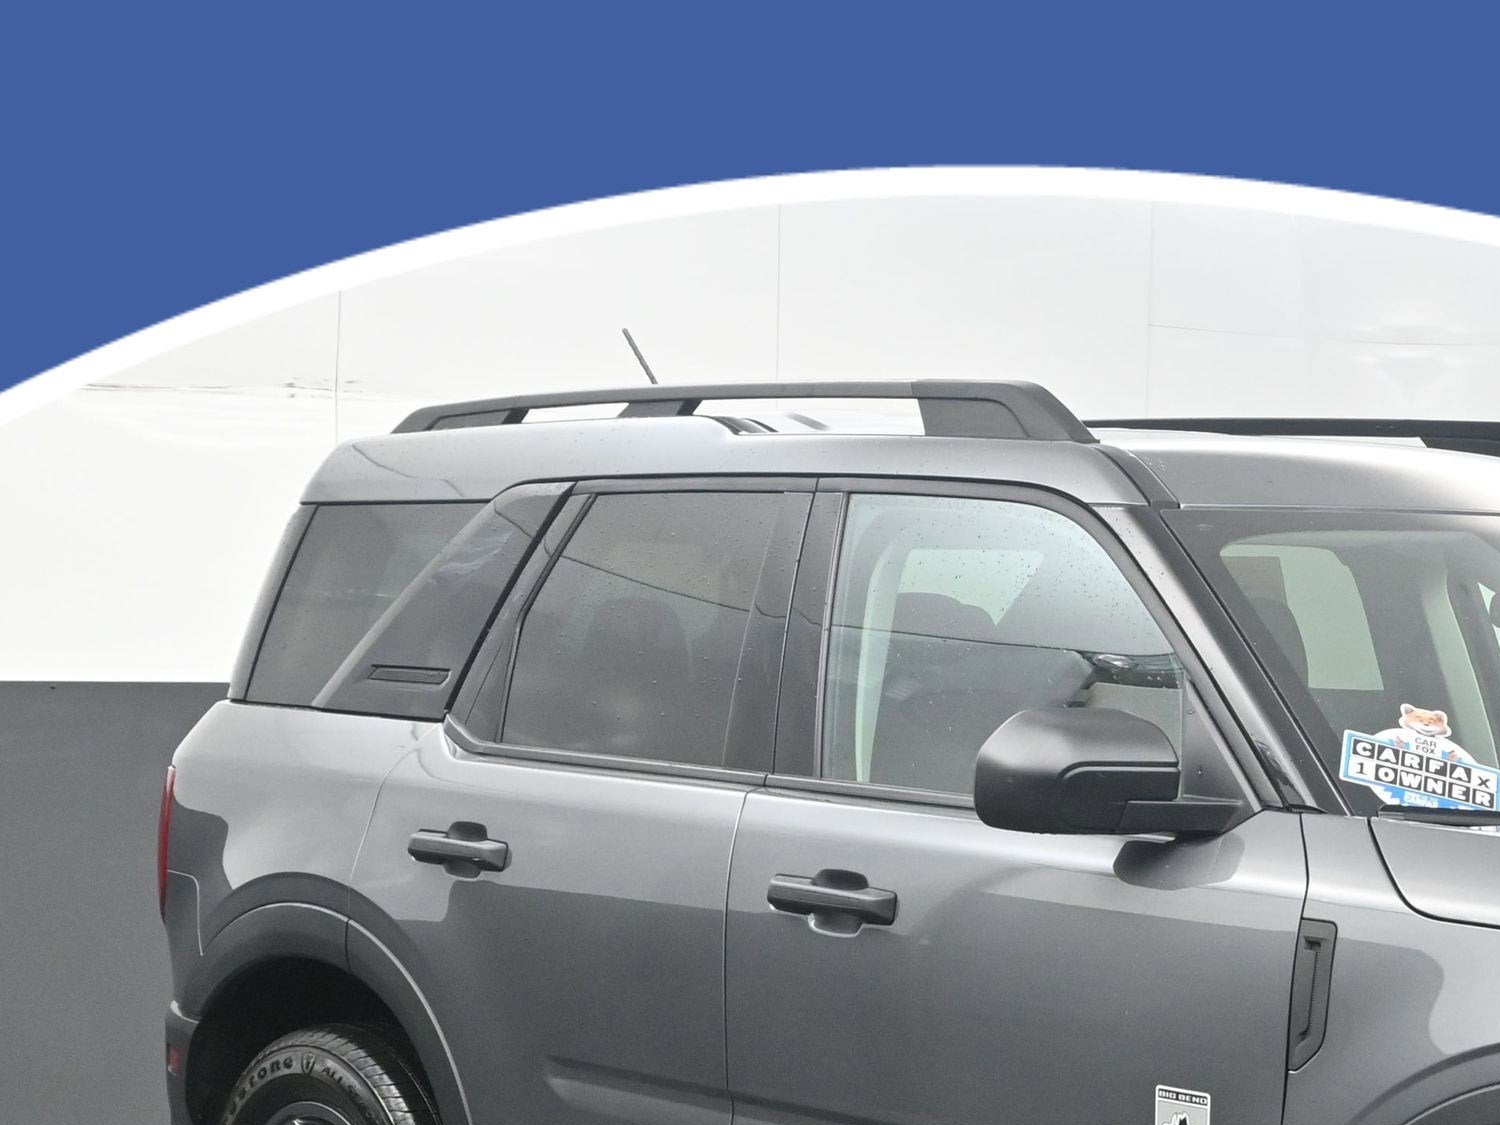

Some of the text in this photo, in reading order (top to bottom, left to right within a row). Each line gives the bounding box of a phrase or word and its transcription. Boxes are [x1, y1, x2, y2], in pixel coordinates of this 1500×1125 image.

[1414, 736, 1438, 748] CAR
[1415, 744, 1437, 755] FOX
[1354, 740, 1493, 790] CARFAX
[1355, 761, 1369, 777] 1
[1377, 765, 1492, 807] OWNER
